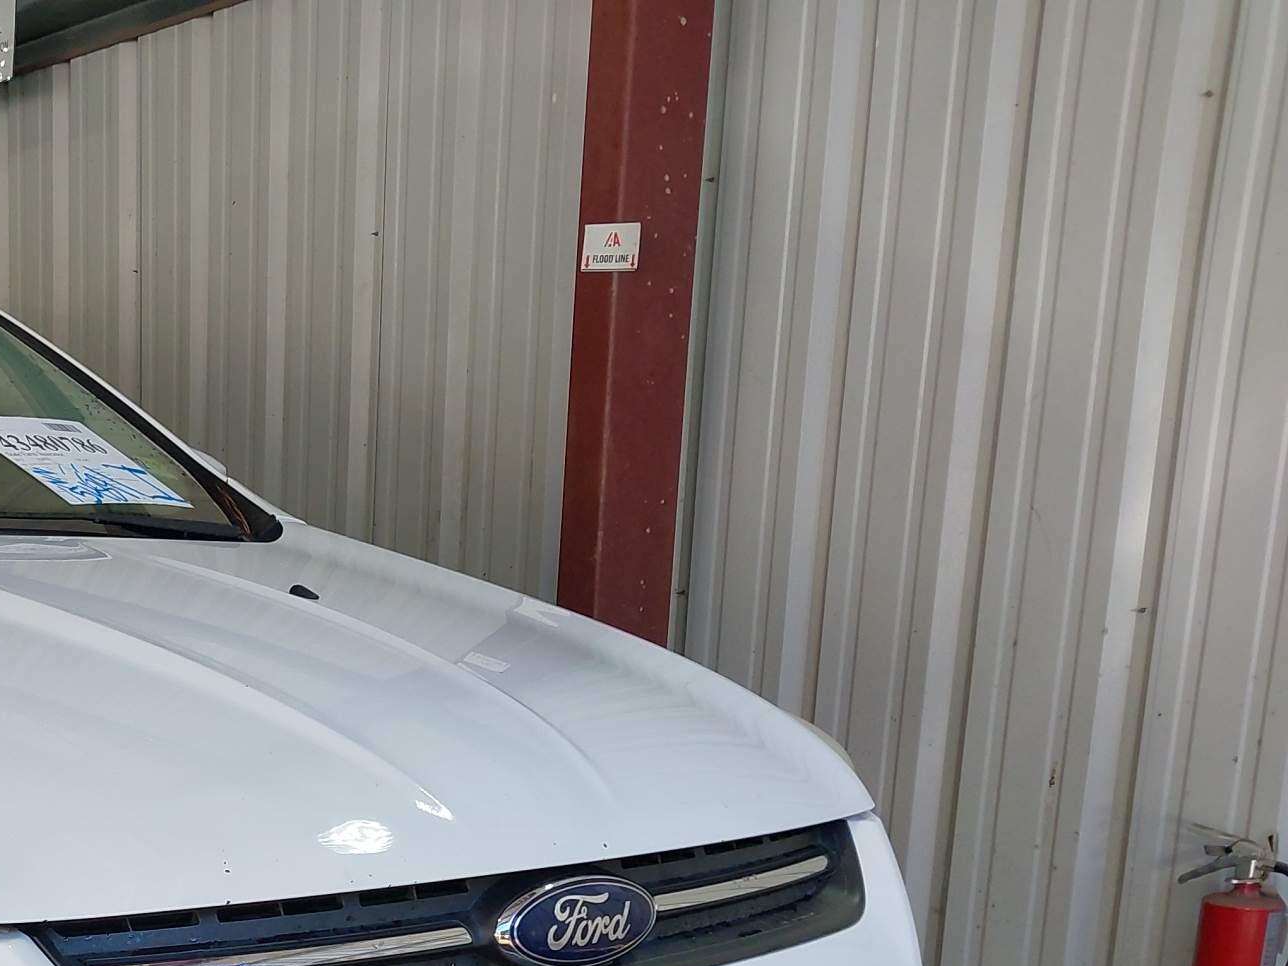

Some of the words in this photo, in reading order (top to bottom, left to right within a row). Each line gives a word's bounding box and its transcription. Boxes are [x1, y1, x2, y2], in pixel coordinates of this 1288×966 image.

[592, 254, 614, 264] FLOOD
[615, 254, 631, 263] LINE
[547, 892, 631, 951] Ford
